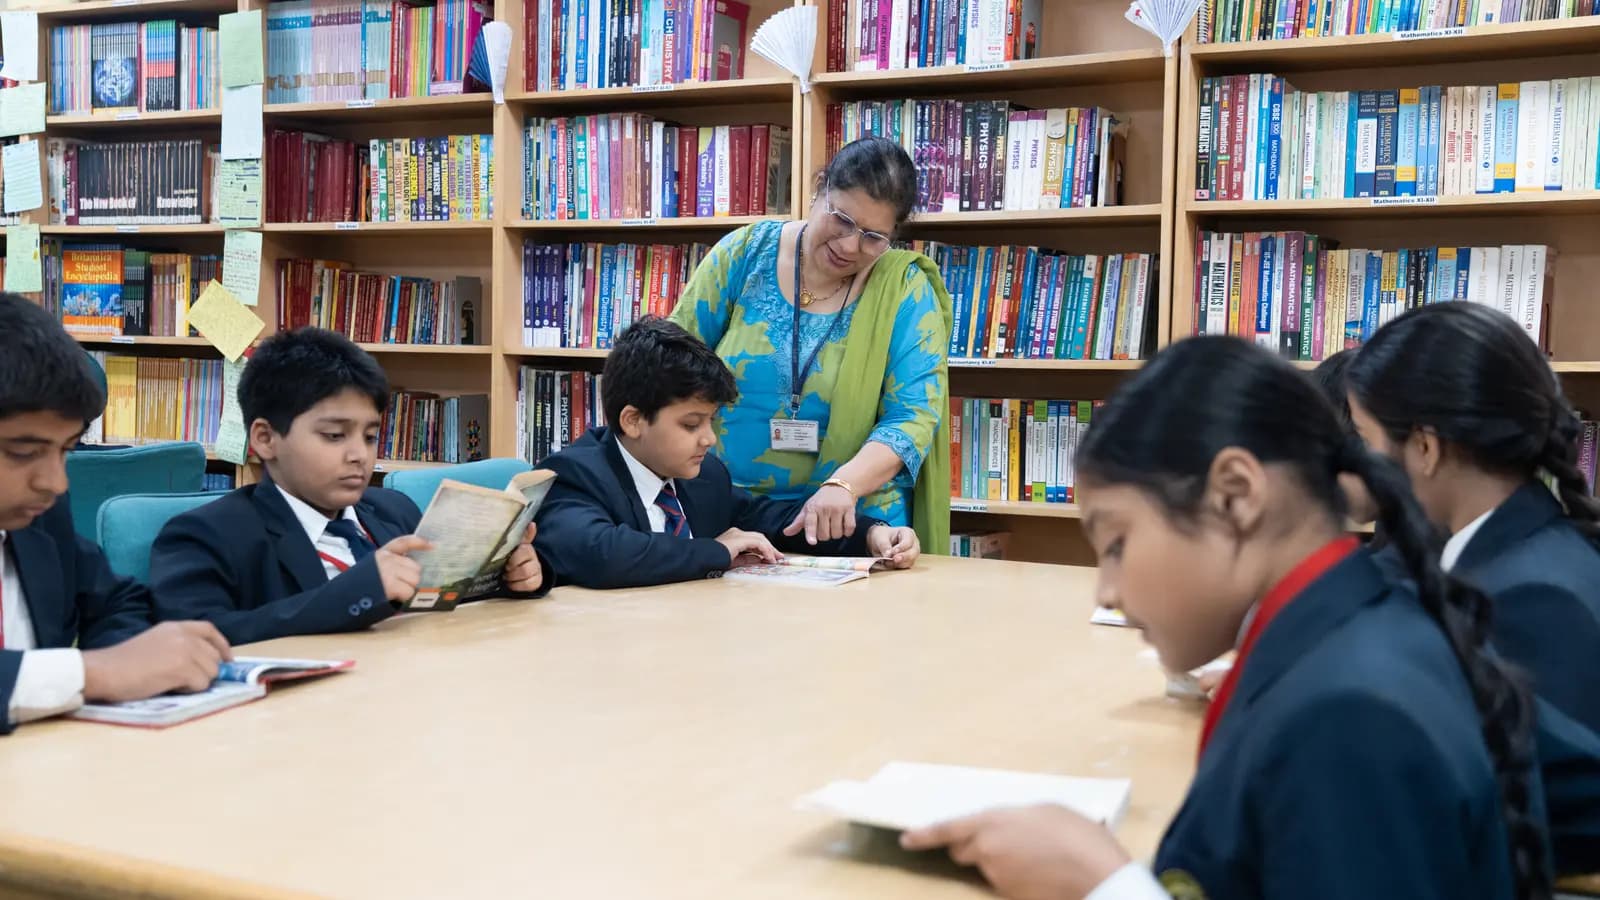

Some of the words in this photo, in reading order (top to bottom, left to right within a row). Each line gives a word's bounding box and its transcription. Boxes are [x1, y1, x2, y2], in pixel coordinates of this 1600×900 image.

[664, 18, 673, 79] CHEMISTRY
[1400, 31, 1442, 39] Mathematics
[1199, 105, 1211, 154] MATHEMATICS
[1272, 104, 1280, 121] CBSE
[1552, 107, 1562, 156] MATHEMATICS
[979, 122, 989, 169] PHYSICS
[1220, 111, 1229, 154] Mathematics
[1361, 123, 1371, 169] MATHEMATICS
[1383, 115, 1393, 163] MATHEMATICS
[1448, 131, 1456, 162] ARITHMETIC
[1464, 131, 1473, 163] ARITHMETIC
[1483, 113, 1492, 160] MATHEMATICS
[1505, 108, 1514, 157] MATHEMATICS
[700, 154, 708, 187] Chemistry
[1012, 140, 1020, 170] PHYSICS
[1030, 139, 1039, 169] PHYSICS
[1047, 142, 1057, 182] PHYSICS
[1269, 140, 1278, 180] MATHEMATICS
[79, 197, 92, 209] The
[109, 197, 128, 209] Book
[157, 196, 197, 209] Knowledge
[71, 252, 112, 262] Britannica
[75, 263, 106, 273] Student
[603, 257, 612, 296] Companion
[652, 255, 661, 292] Companion
[66, 271, 118, 283] Encyclopedia
[1211, 262, 1225, 306] MATHEMATICS
[1232, 261, 1241, 297] MATHEMATICS
[1261, 270, 1270, 302] Mathematics
[1288, 262, 1297, 315] MATHEMATICS
[601, 296, 609, 334] Chemistry
[1030, 299, 1038, 327] STUDIES
[1079, 282, 1090, 323] MATHEMATICS
[1260, 302, 1268, 329] Challenger
[1350, 273, 1359, 321] MATHEMATICS
[1526, 273, 1536, 322] MATHEMATICS
[1302, 308, 1311, 355] MATHEMATICS
[560, 397, 569, 442] PHYSICS
